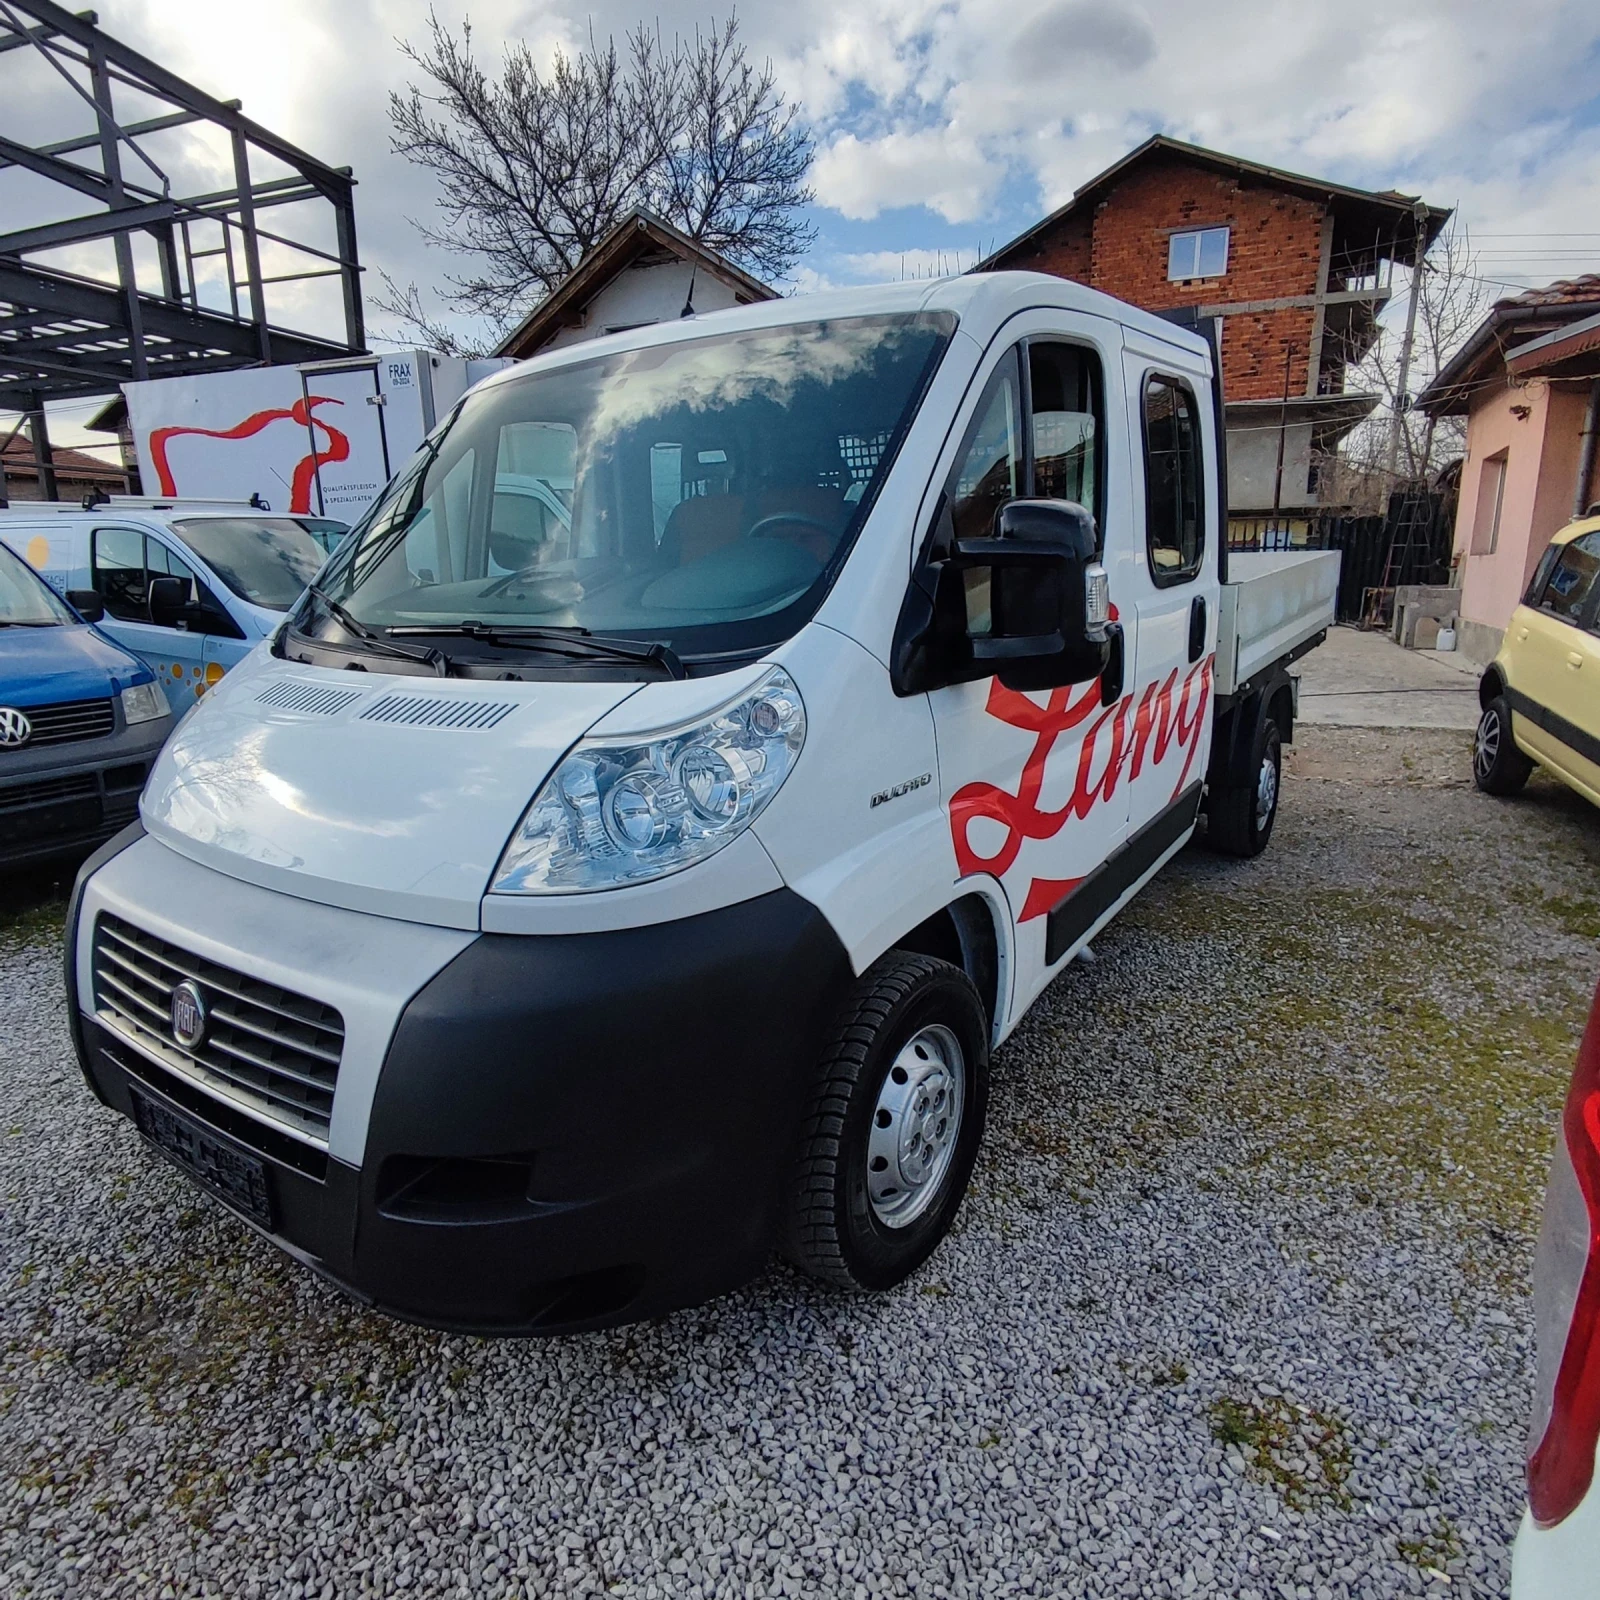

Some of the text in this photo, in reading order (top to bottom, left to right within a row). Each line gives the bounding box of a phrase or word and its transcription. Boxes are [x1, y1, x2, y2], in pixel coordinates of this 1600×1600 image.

[388, 362, 412, 379] FRAX
[322, 483, 378, 493] QUALITÄTSFLEISCH
[869, 772, 932, 809] DUCATO
